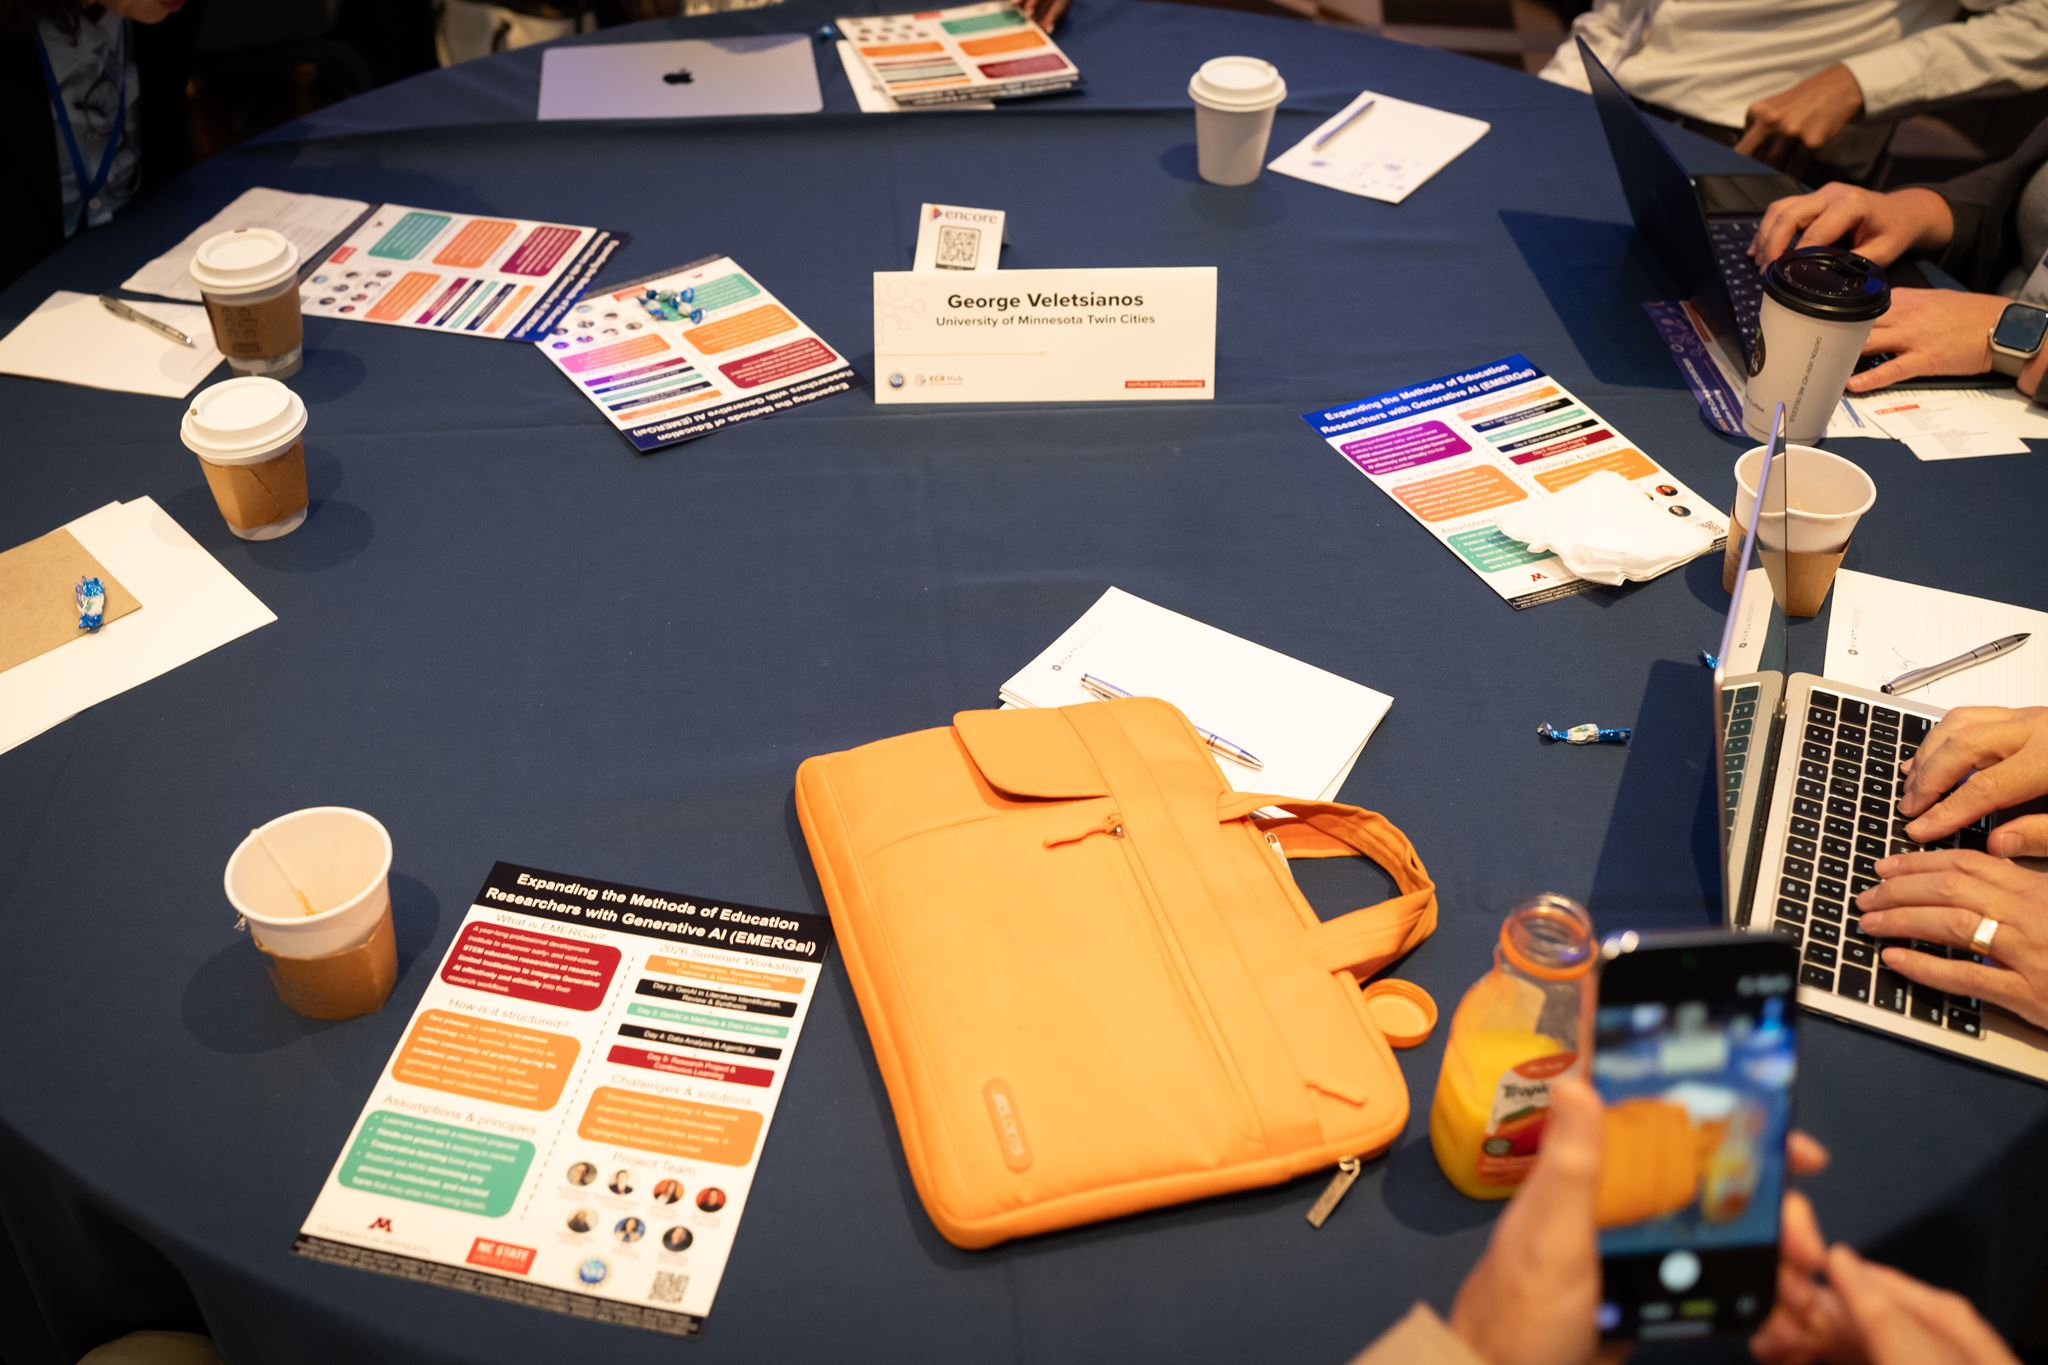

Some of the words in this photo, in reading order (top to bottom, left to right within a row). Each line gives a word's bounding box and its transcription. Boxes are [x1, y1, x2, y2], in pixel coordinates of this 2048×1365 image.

[945, 210, 998, 224] encore
[947, 294, 1021, 312] George
[1027, 292, 1144, 308] Veletsianos
[936, 316, 998, 328] University
[1002, 316, 1014, 325] of
[1018, 315, 1083, 325] Minnesota
[1088, 314, 1116, 324] Twin
[1120, 313, 1156, 324] Cities
[1324, 401, 1382, 420] Expanding
[1381, 396, 1399, 404] the
[1399, 383, 1444, 399] Methods
[1445, 378, 1457, 386] of
[1456, 364, 1509, 383] Education
[1320, 412, 1386, 433] Researchers
[1387, 405, 1411, 415] with
[1411, 390, 1466, 408] Generative
[486, 887, 580, 914] Researchers
[585, 908, 617, 921] with
[622, 913, 705, 936] Generative
[707, 927, 727, 940] AI
[517, 873, 597, 900] Expanding
[601, 889, 626, 902] the
[629, 893, 695, 914] Methods
[700, 906, 718, 917] of
[719, 908, 798, 930] Education
[496, 914, 525, 925] What
[527, 919, 539, 928] is
[478, 928, 509, 938] year-long
[508, 934, 548, 945] professional
[548, 941, 589, 953] development
[457, 954, 482, 964] limited
[482, 959, 520, 972] institutions
[530, 969, 561, 980] integrate
[562, 975, 599, 987] Generative
[463, 944, 484, 953] STEM
[484, 950, 518, 960] education
[518, 957, 559, 969] researchers
[568, 966, 601, 976] resource-
[659, 944, 687, 954] 2026
[692, 949, 740, 963] Summer
[749, 958, 802, 973] Workshop
[461, 966, 497, 979] effectively
[511, 977, 541, 988] ethically
[448, 998, 474, 1010] How
[476, 1003, 491, 1014] is
[490, 1006, 501, 1016] it
[501, 1011, 568, 1028] structured?
[611, 1075, 678, 1097] Challenges
[682, 1086, 694, 1097] &
[696, 1091, 751, 1105] solutions
[383, 1094, 461, 1119] Assumptions
[463, 1111, 477, 1123] &
[476, 1116, 536, 1134] principles
[612, 1151, 657, 1168] Project
[663, 1161, 695, 1174] Team
